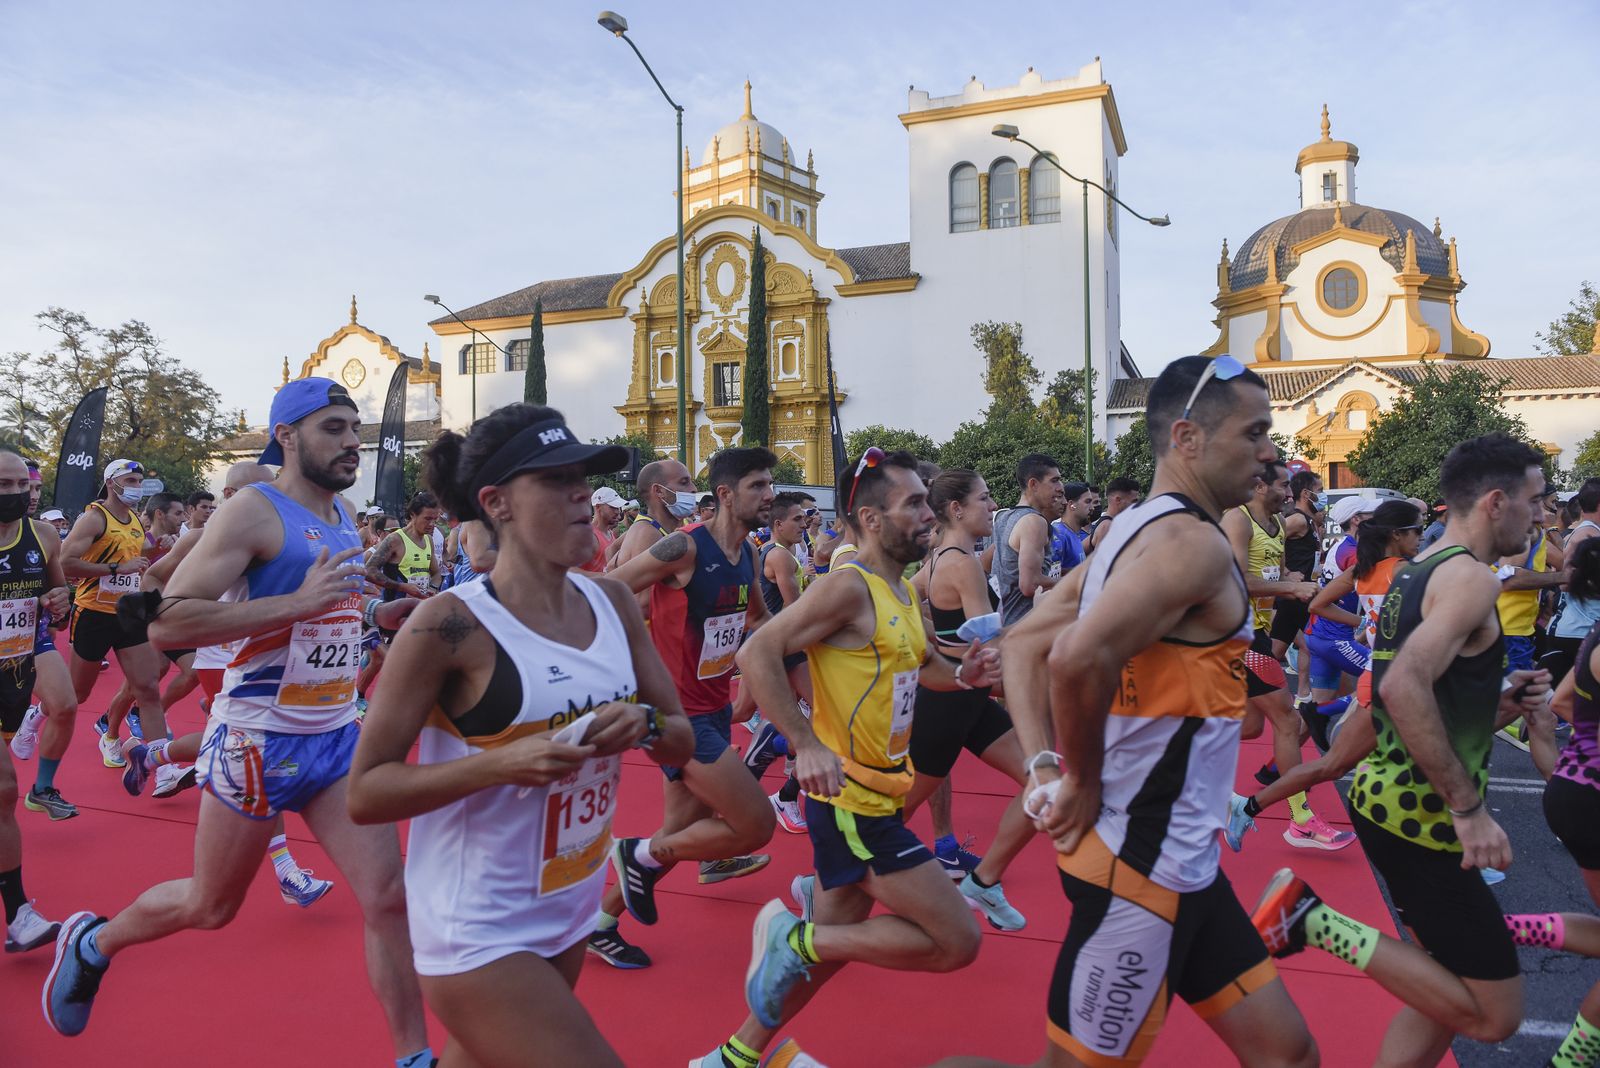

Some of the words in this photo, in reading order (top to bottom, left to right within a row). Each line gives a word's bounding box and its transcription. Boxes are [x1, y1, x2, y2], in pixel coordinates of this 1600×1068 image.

[538, 428, 567, 445] HH
[66, 451, 94, 471] edp
[1325, 520, 1342, 535] ra
[109, 575, 132, 587] 450
[301, 628, 319, 638] edp
[713, 628, 736, 649] 158
[306, 644, 348, 669] 422
[559, 781, 610, 830] 138
[1074, 964, 1105, 1023] running
[1095, 950, 1149, 1050] eMotion
